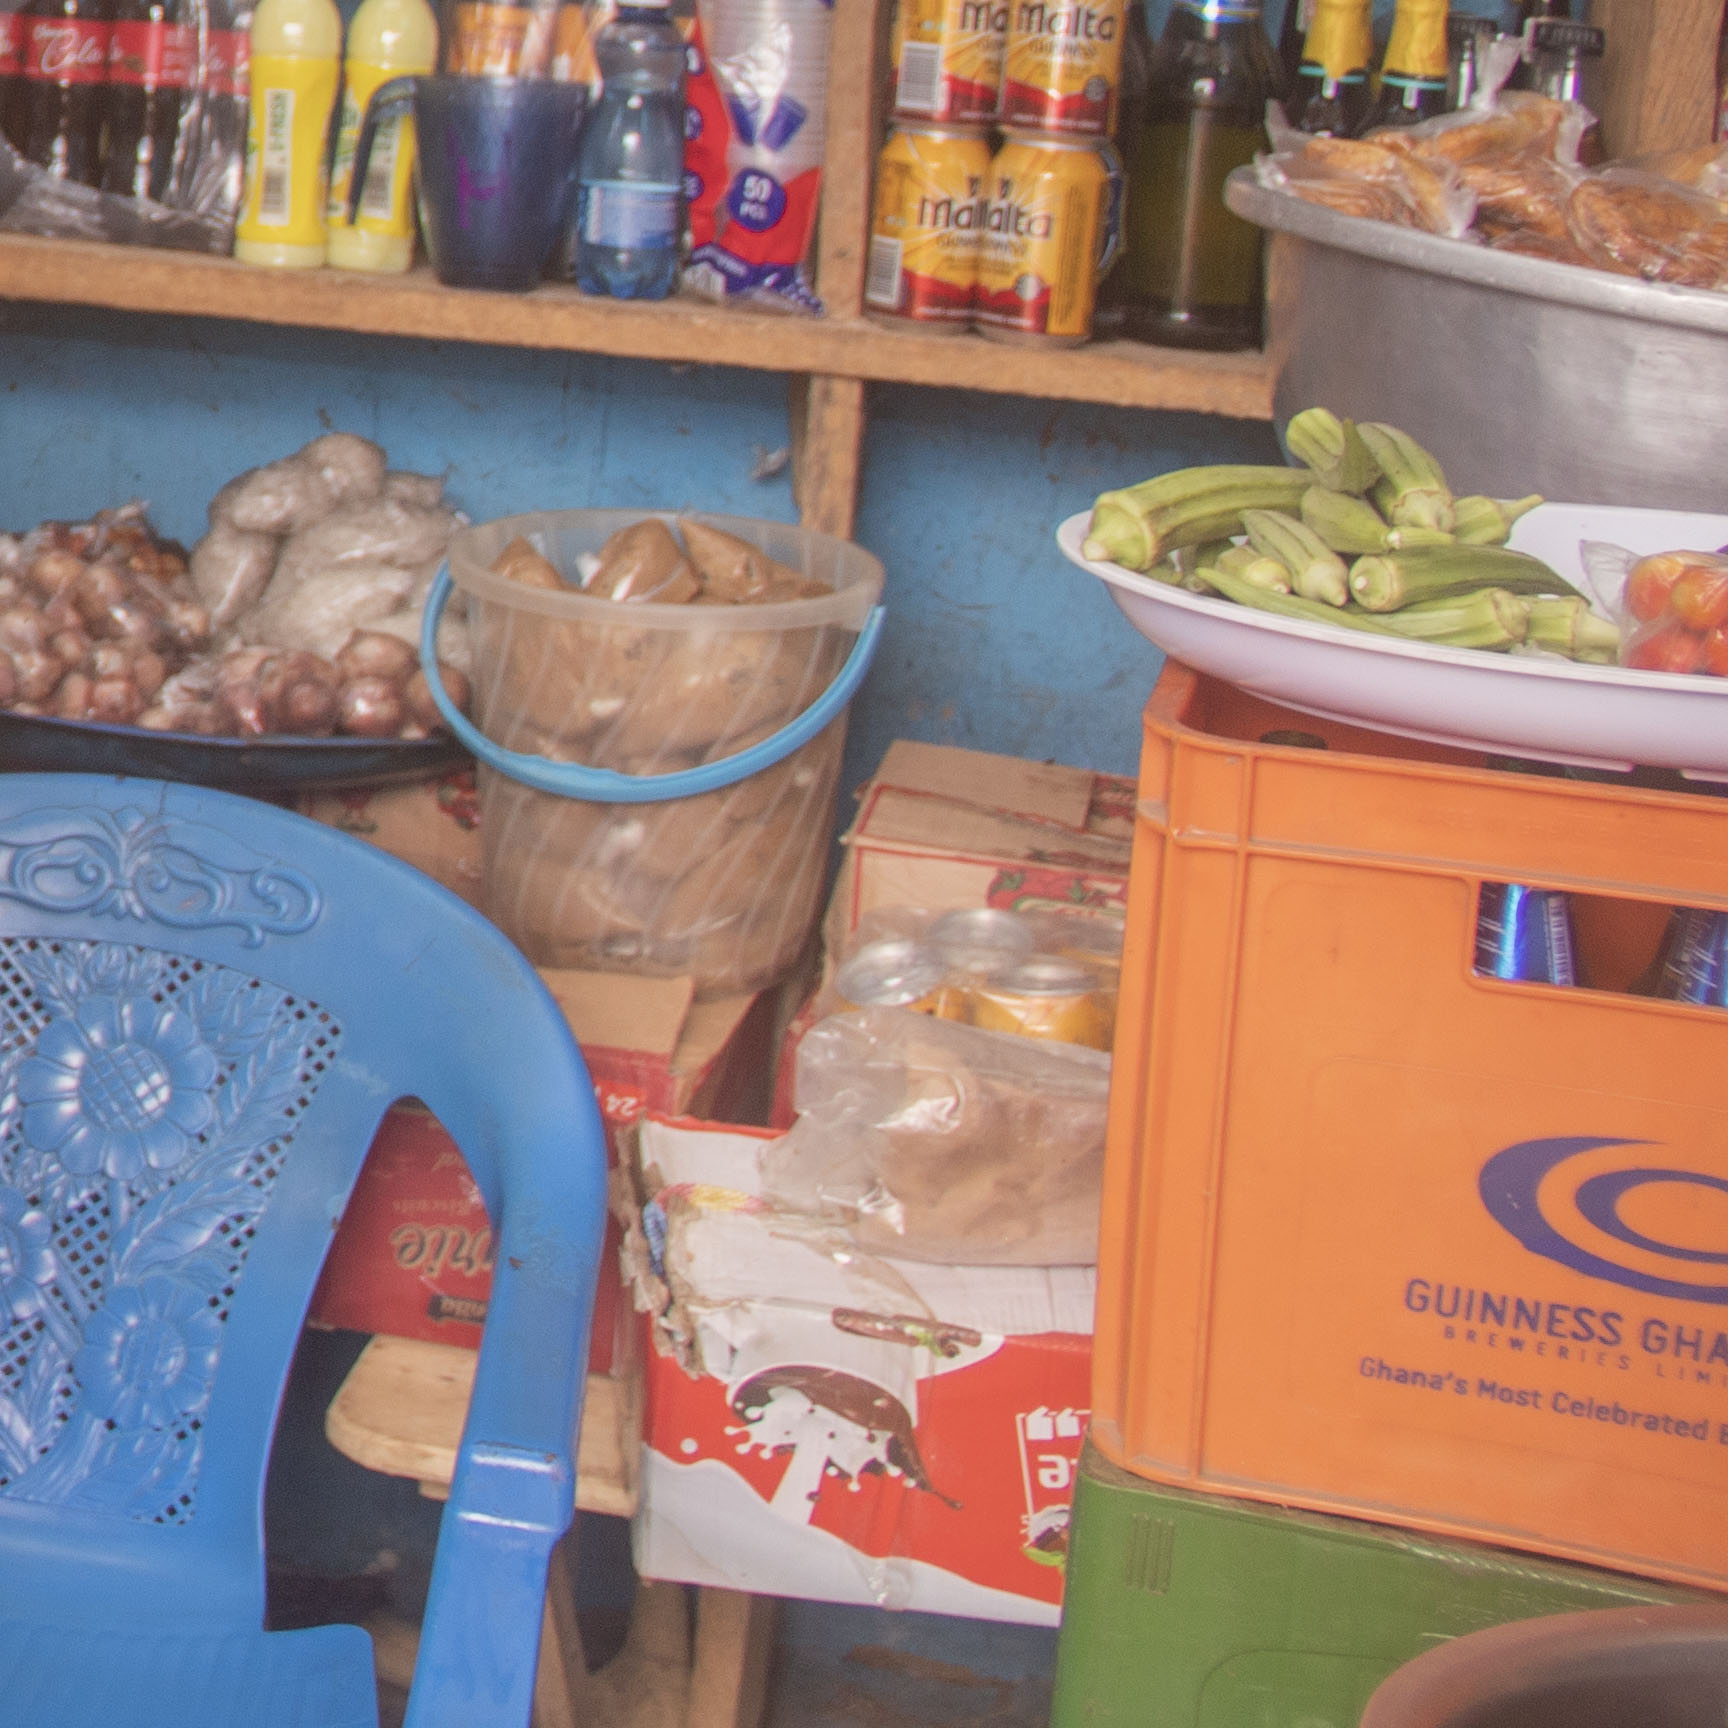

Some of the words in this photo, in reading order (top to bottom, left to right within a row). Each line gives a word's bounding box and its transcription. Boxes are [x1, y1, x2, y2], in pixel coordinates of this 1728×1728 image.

[741, 172, 773, 204] 50
[1404, 1277, 1625, 1348] GUINNESS
[1443, 1324, 1632, 1372] BREWERIES
[1358, 1354, 1469, 1397] Ghana's
[1476, 1377, 1544, 1412] Most
[1550, 1390, 1711, 1444] Celebrated
